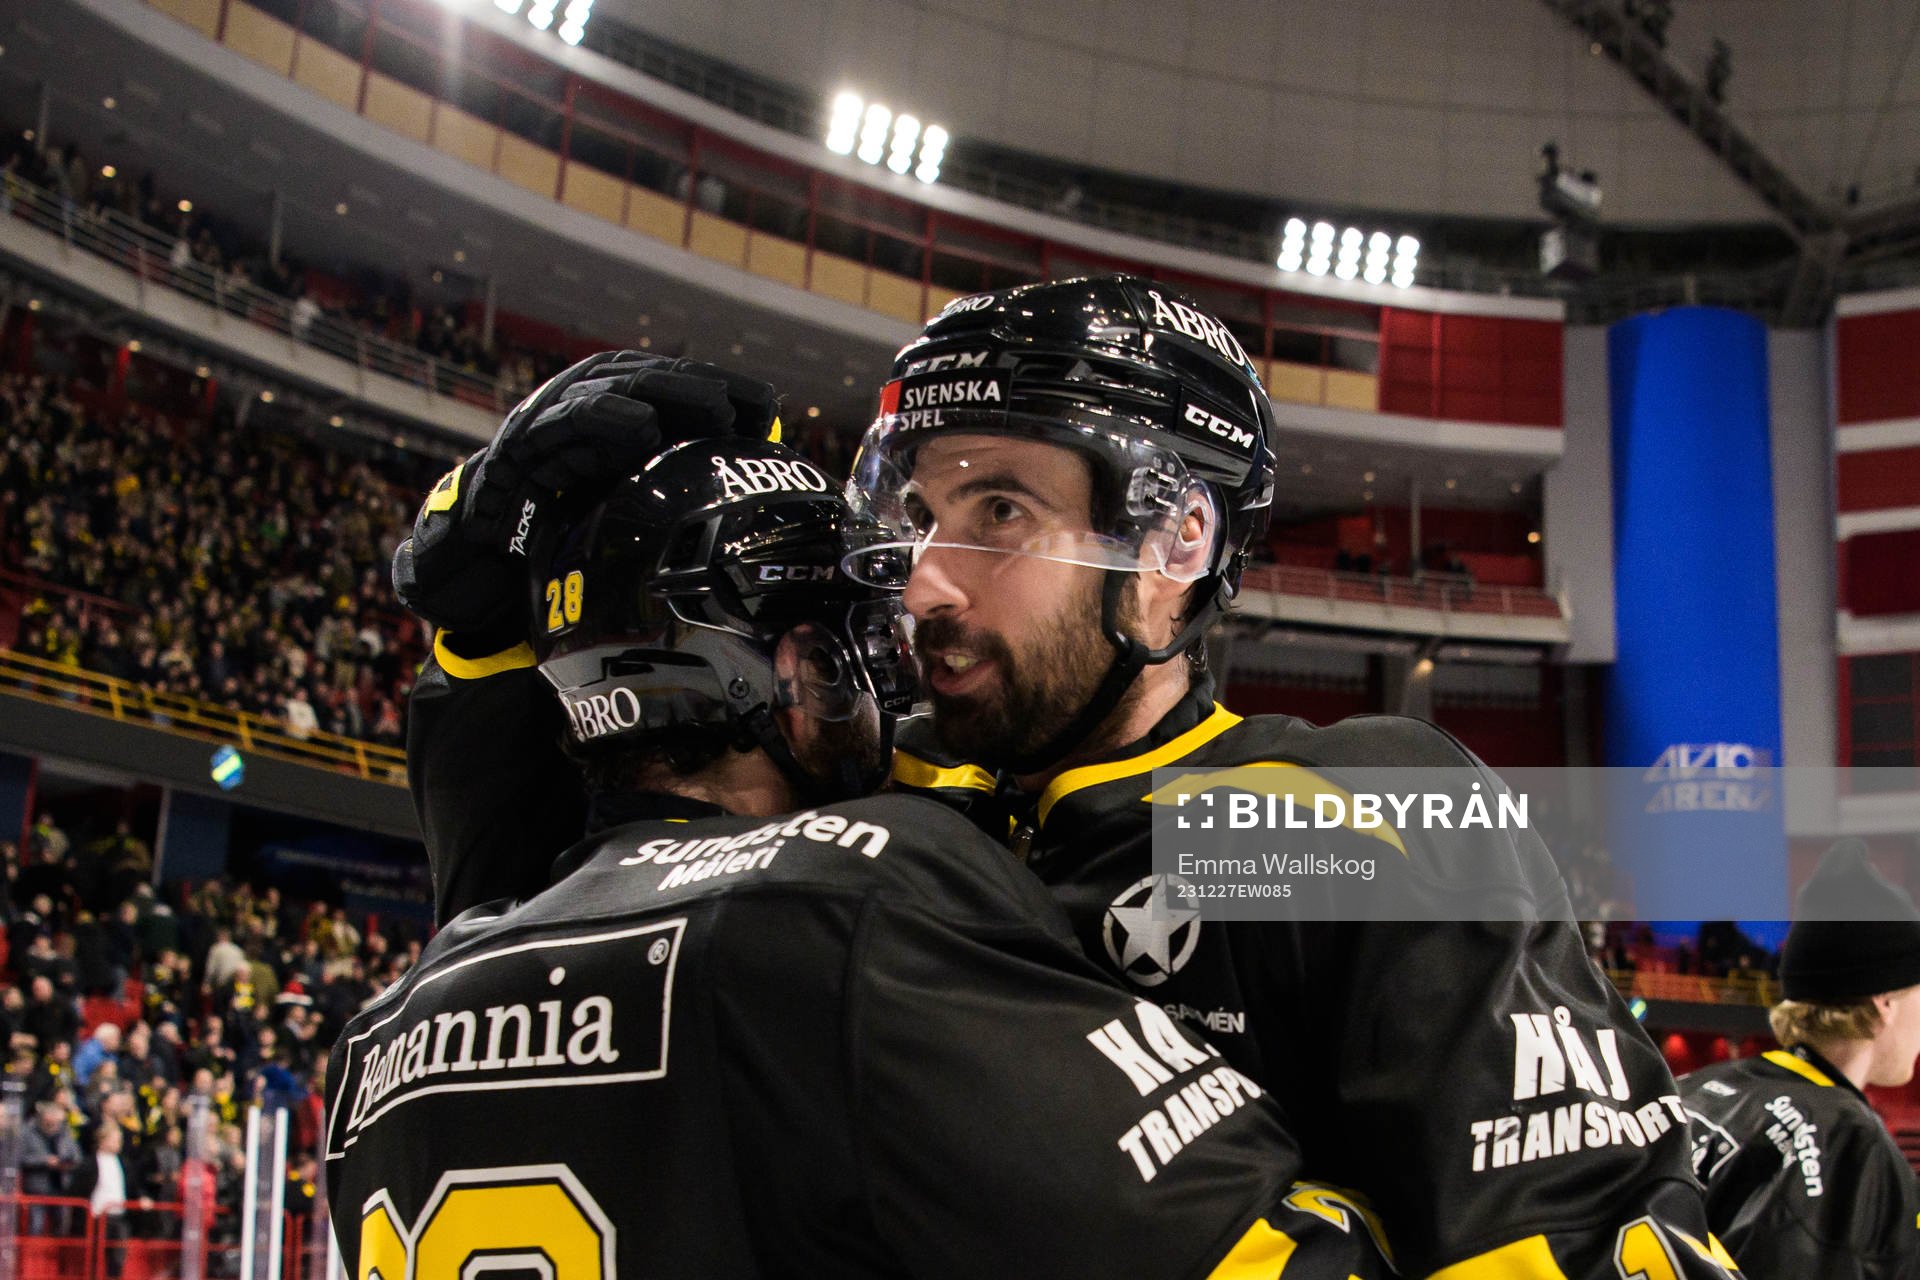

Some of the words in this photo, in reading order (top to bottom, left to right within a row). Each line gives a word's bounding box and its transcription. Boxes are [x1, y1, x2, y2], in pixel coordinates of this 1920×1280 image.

[1148, 290, 1246, 366] ÅBRO
[899, 408, 945, 431] SPEL
[904, 380, 1001, 410] SVENSKA
[1184, 403, 1255, 449] CCM
[711, 456, 827, 498] ÅBRO
[509, 498, 536, 556] TACKS
[758, 565, 835, 581] CCM
[546, 570, 584, 633] 28
[619, 810, 890, 858] Sundsten
[1510, 1005, 1631, 1101] HÅJ
[1471, 1095, 1688, 1172] TRANSPORT
[1764, 1095, 1824, 1197] Sundsten
